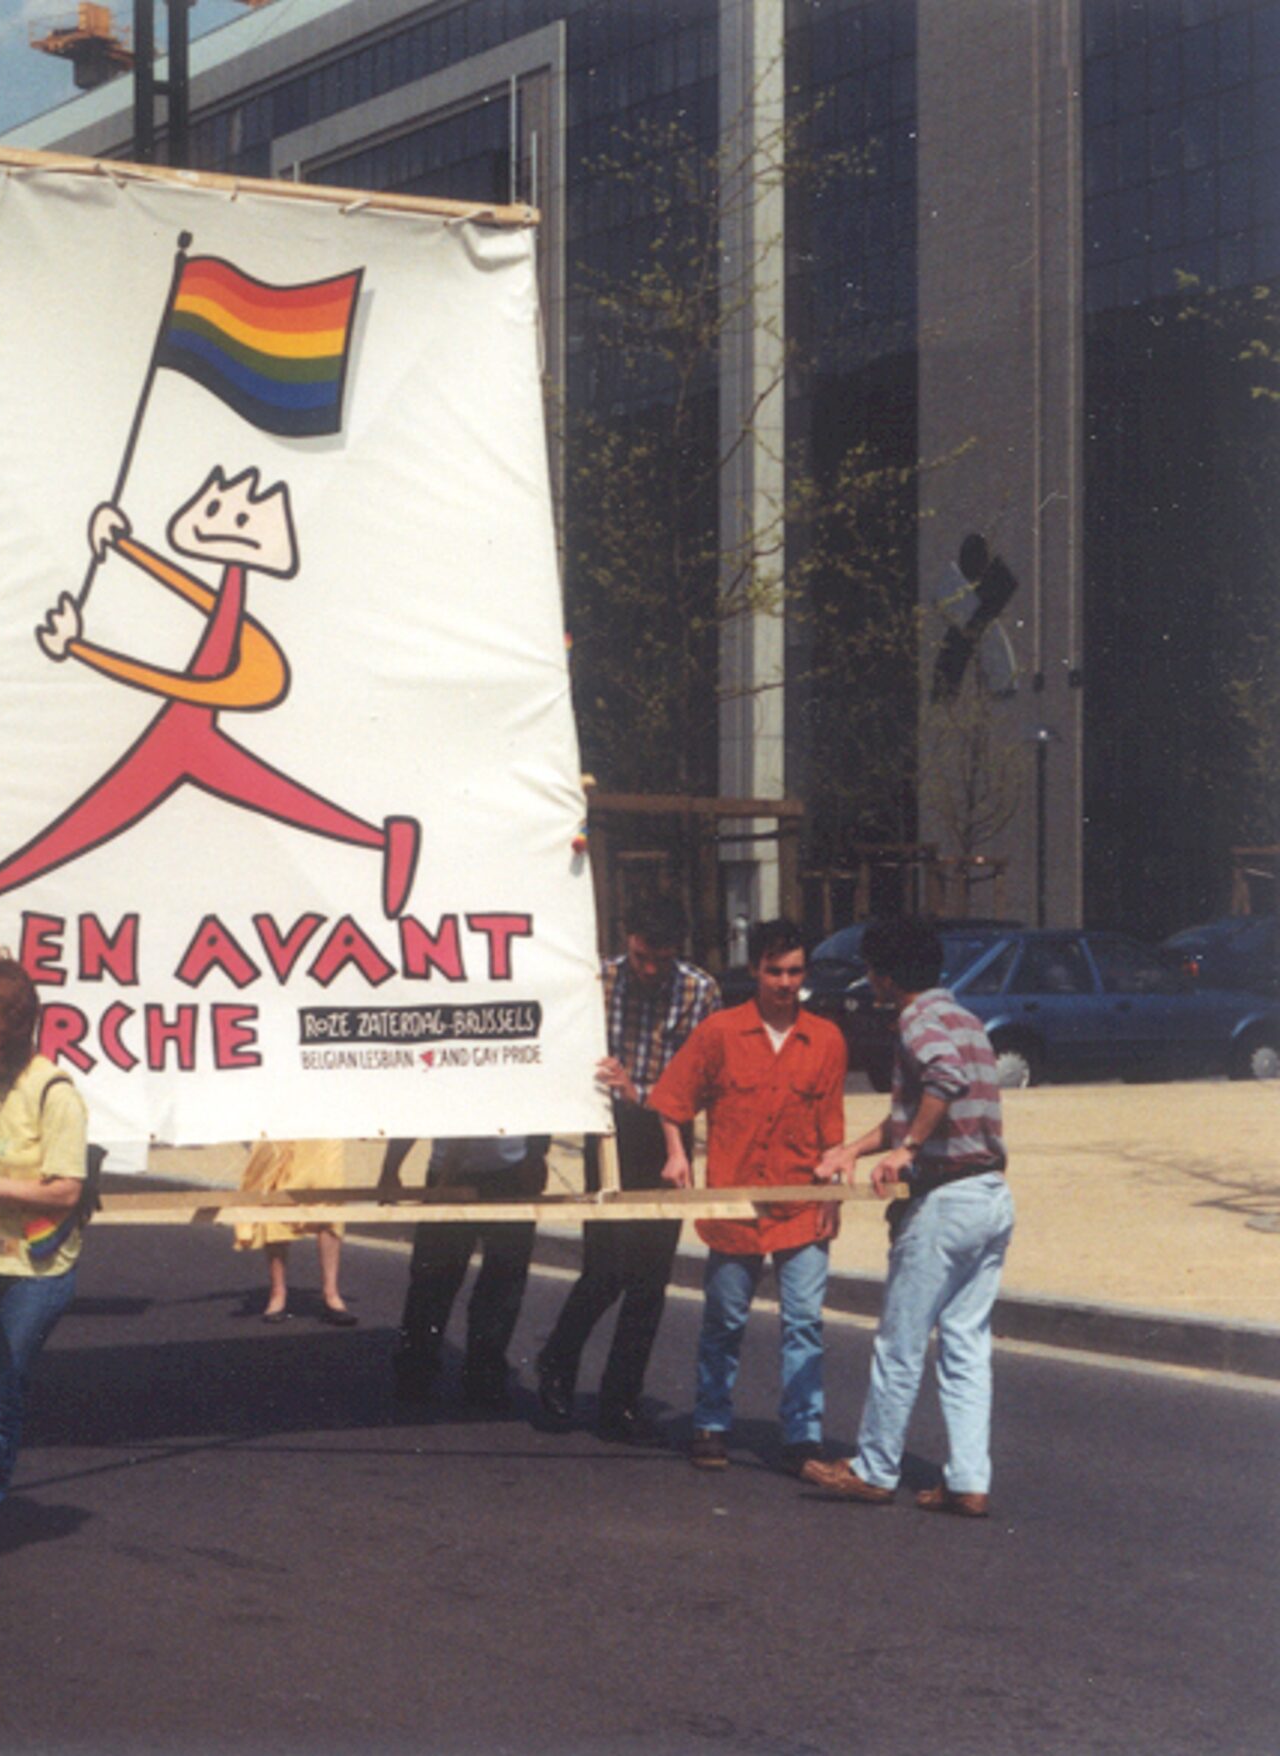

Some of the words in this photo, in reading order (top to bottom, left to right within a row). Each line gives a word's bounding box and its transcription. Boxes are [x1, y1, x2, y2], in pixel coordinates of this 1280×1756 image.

[20, 910, 139, 986] EN
[174, 912, 533, 989] AVANT
[302, 1050, 357, 1070] BELGIAN
[360, 1050, 414, 1070] LESBIAN
[439, 1048, 469, 1067] AND
[473, 1046, 499, 1066] GAY
[502, 1045, 543, 1065] PRIDE
